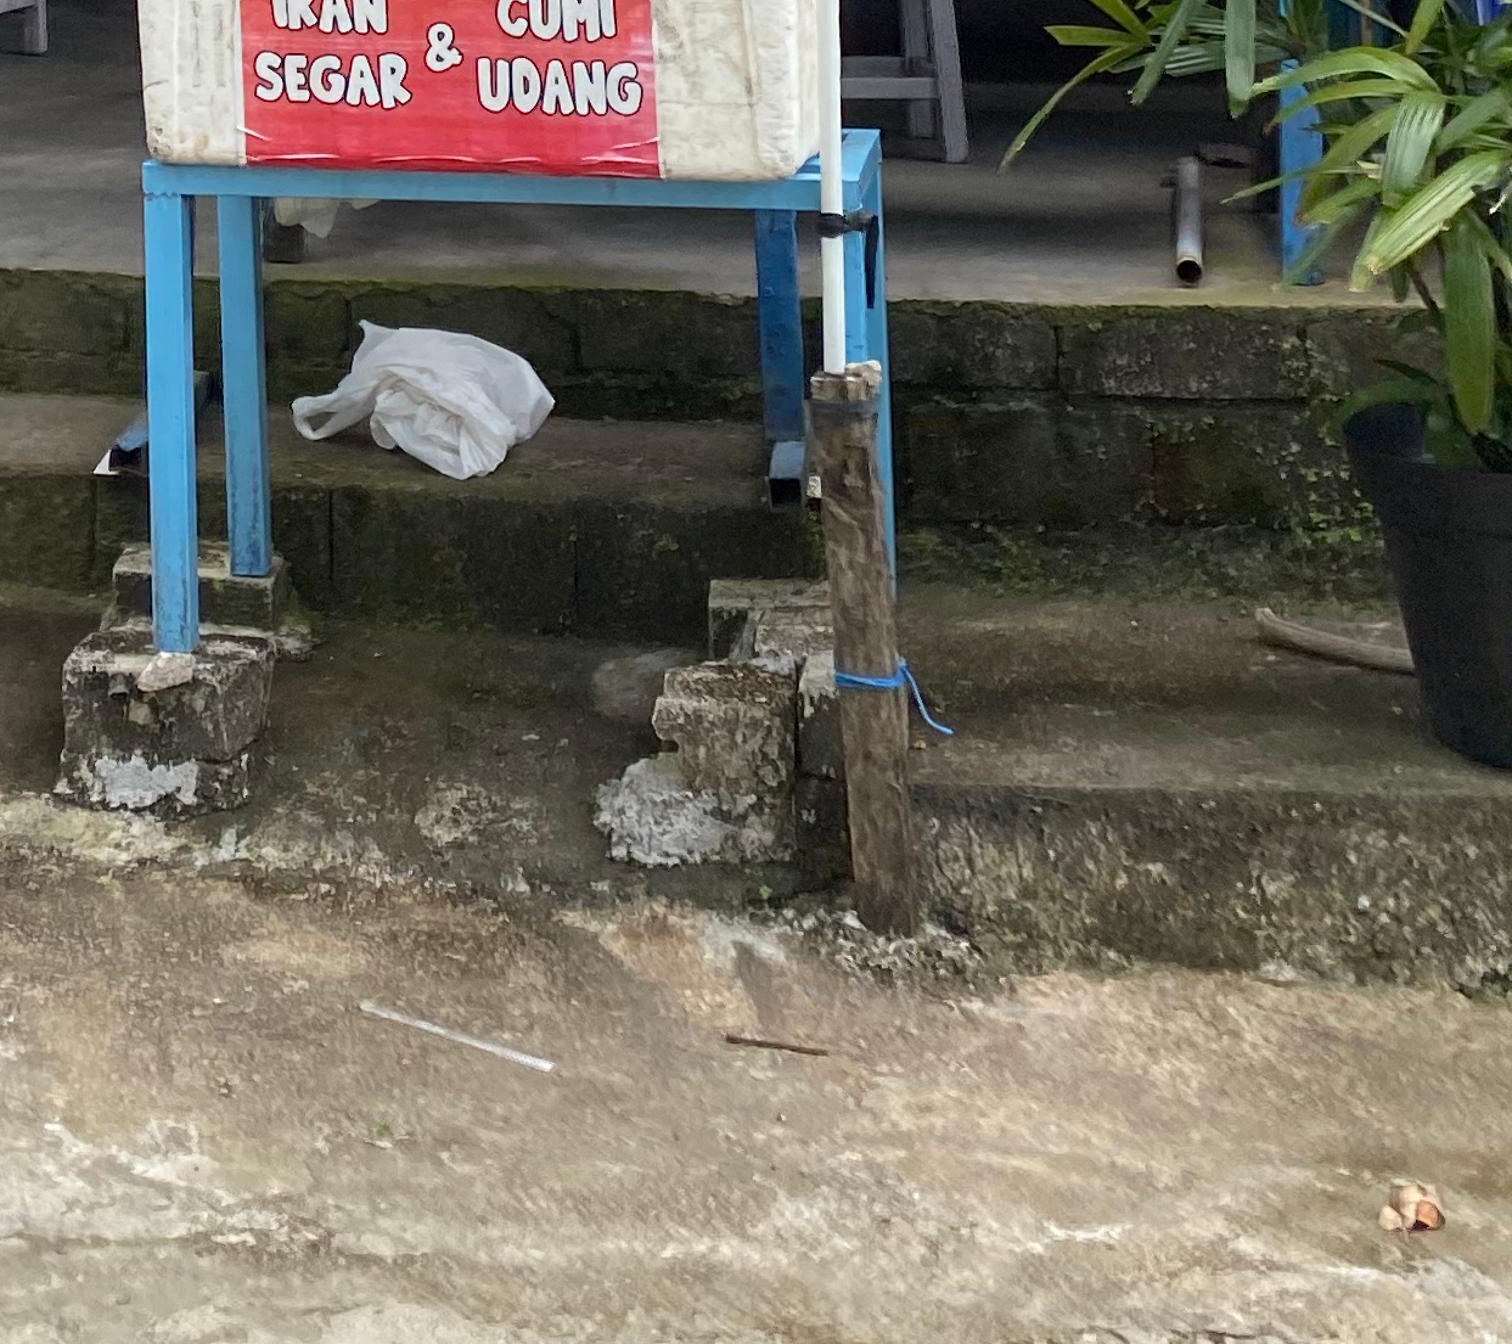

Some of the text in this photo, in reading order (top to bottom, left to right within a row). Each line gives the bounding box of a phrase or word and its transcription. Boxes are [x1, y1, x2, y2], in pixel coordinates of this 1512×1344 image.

[425, 22, 464, 73] &
[254, 53, 413, 110] SEGAR
[475, 58, 643, 117] UDANG
